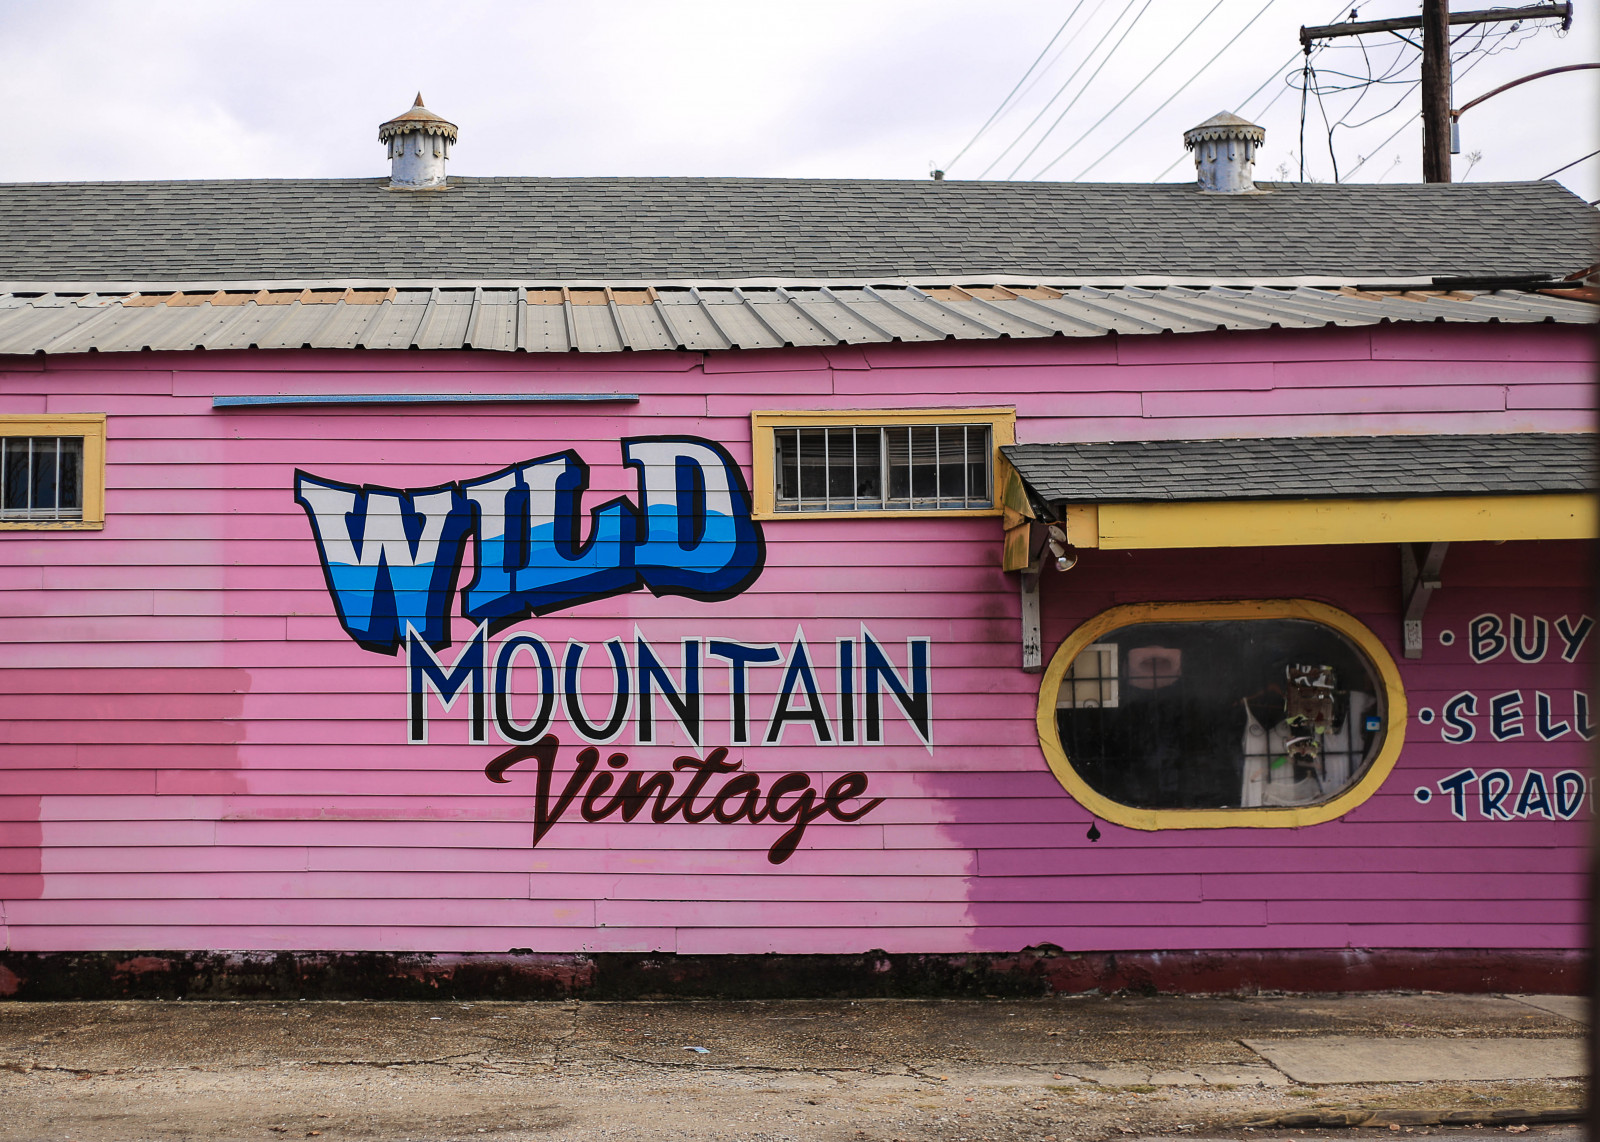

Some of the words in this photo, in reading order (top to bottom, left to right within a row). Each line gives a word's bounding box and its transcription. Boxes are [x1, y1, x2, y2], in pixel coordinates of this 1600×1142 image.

[294, 434, 767, 656] WILD
[406, 619, 933, 756] MOUNTAIN
[1469, 613, 1596, 664] BUY
[485, 733, 886, 864] Vintage
[1437, 768, 1597, 821] TRAD
